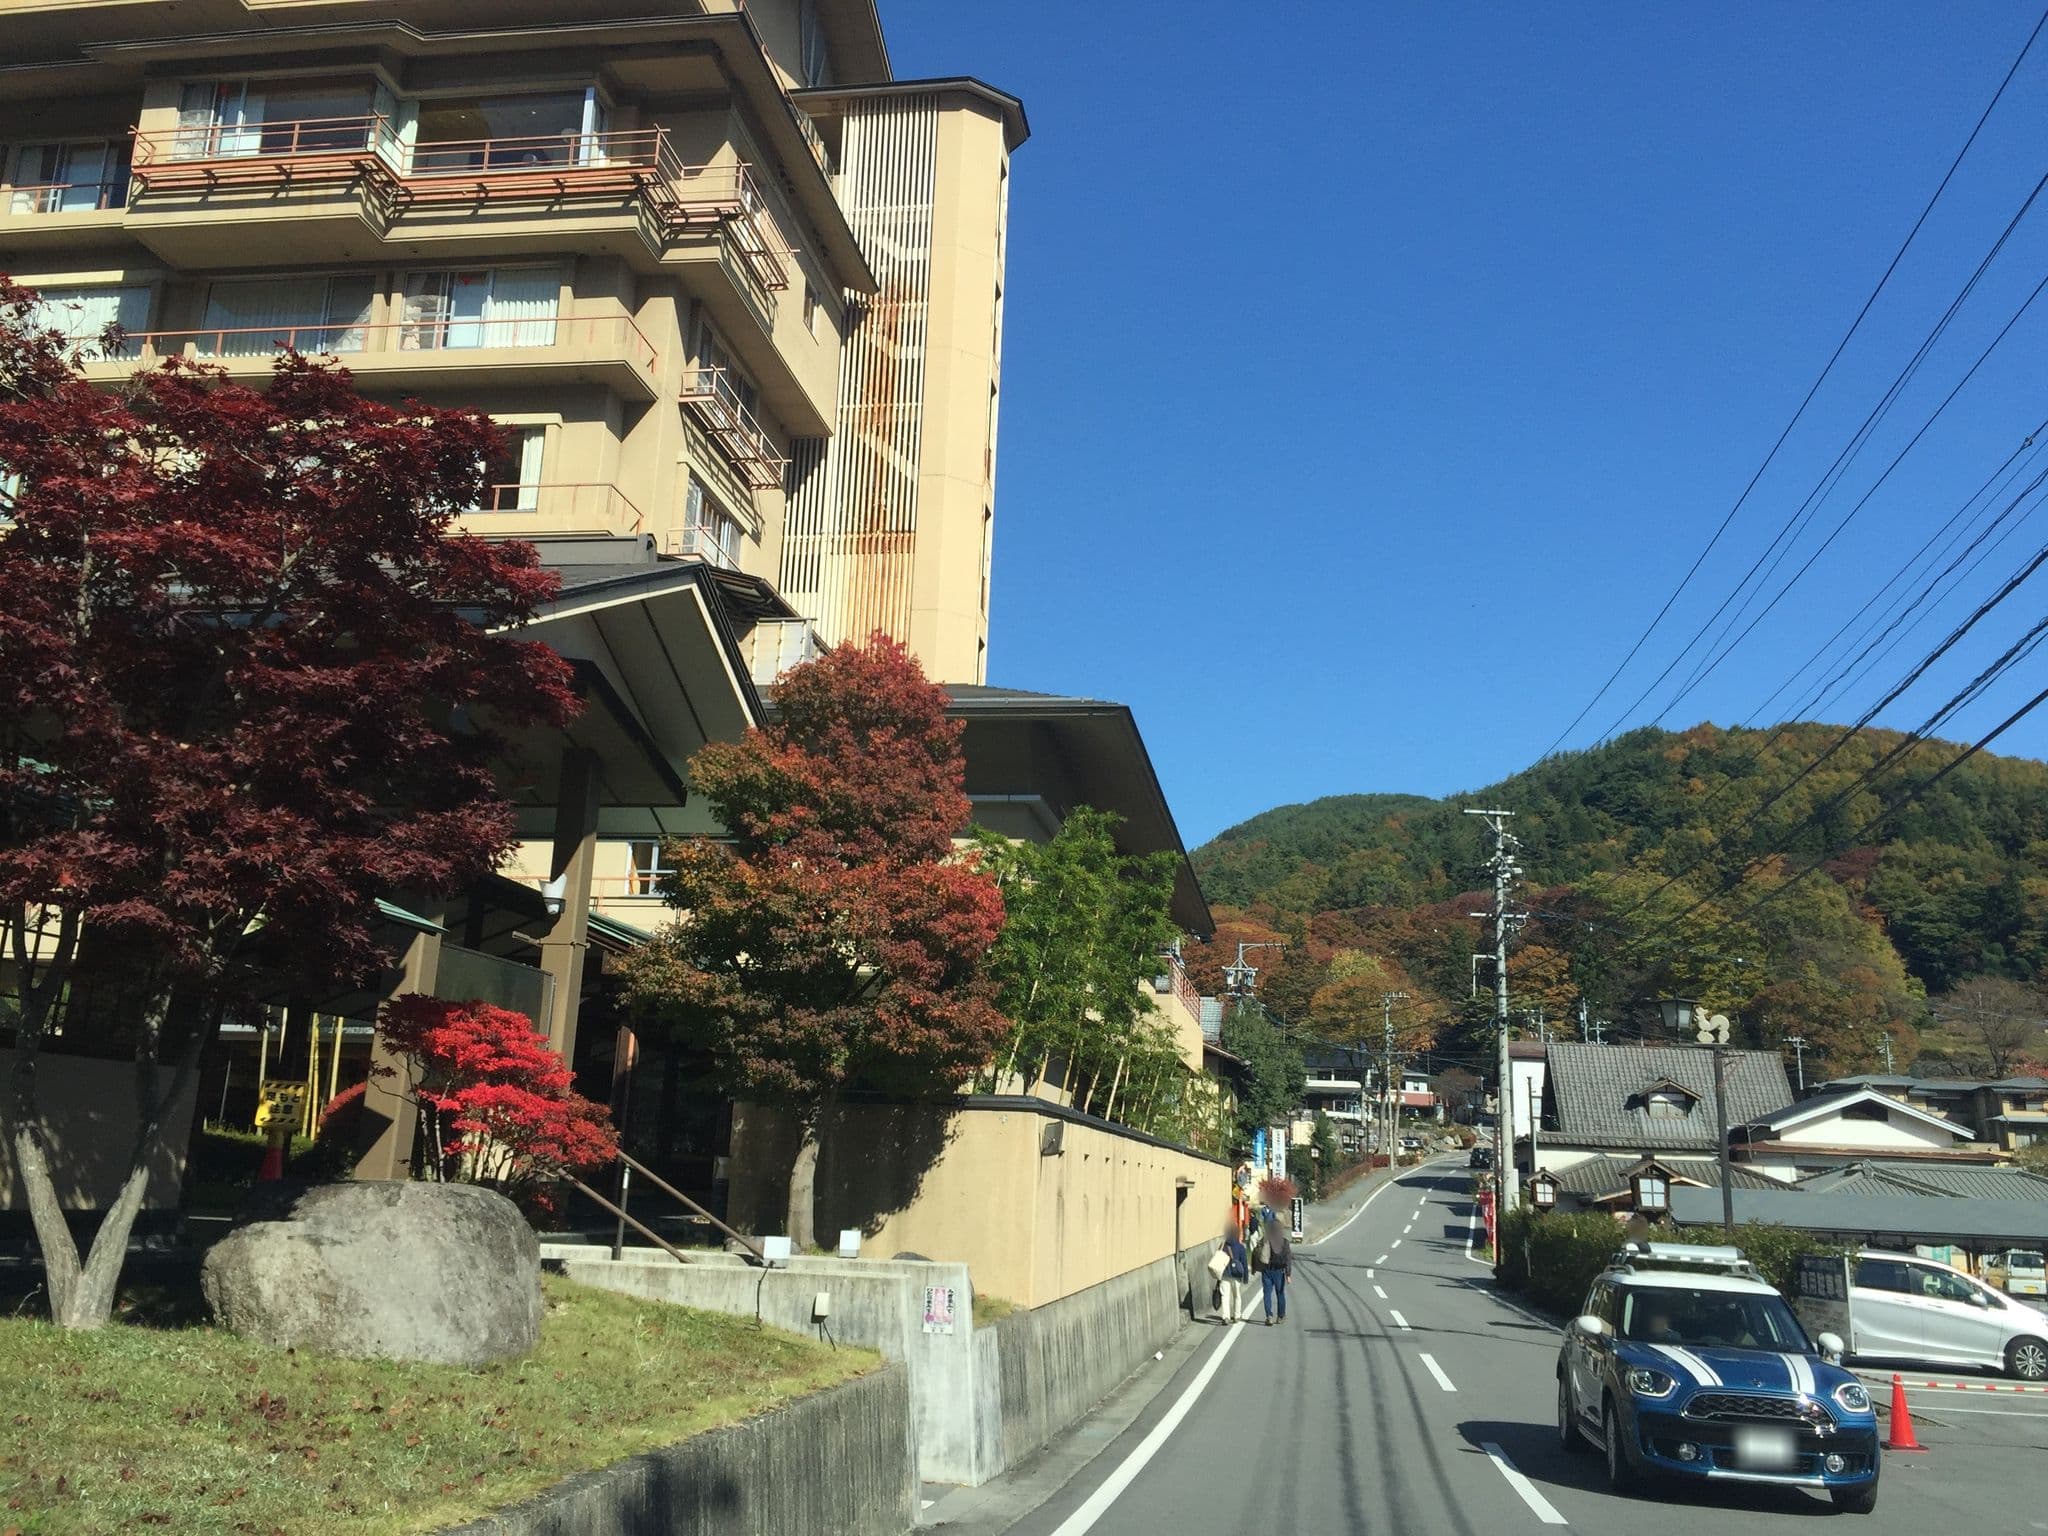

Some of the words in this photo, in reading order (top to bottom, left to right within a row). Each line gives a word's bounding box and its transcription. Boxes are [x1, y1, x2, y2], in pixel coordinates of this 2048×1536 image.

[266, 1092, 300, 1102] 足もと
[270, 1103, 293, 1114] 注意
